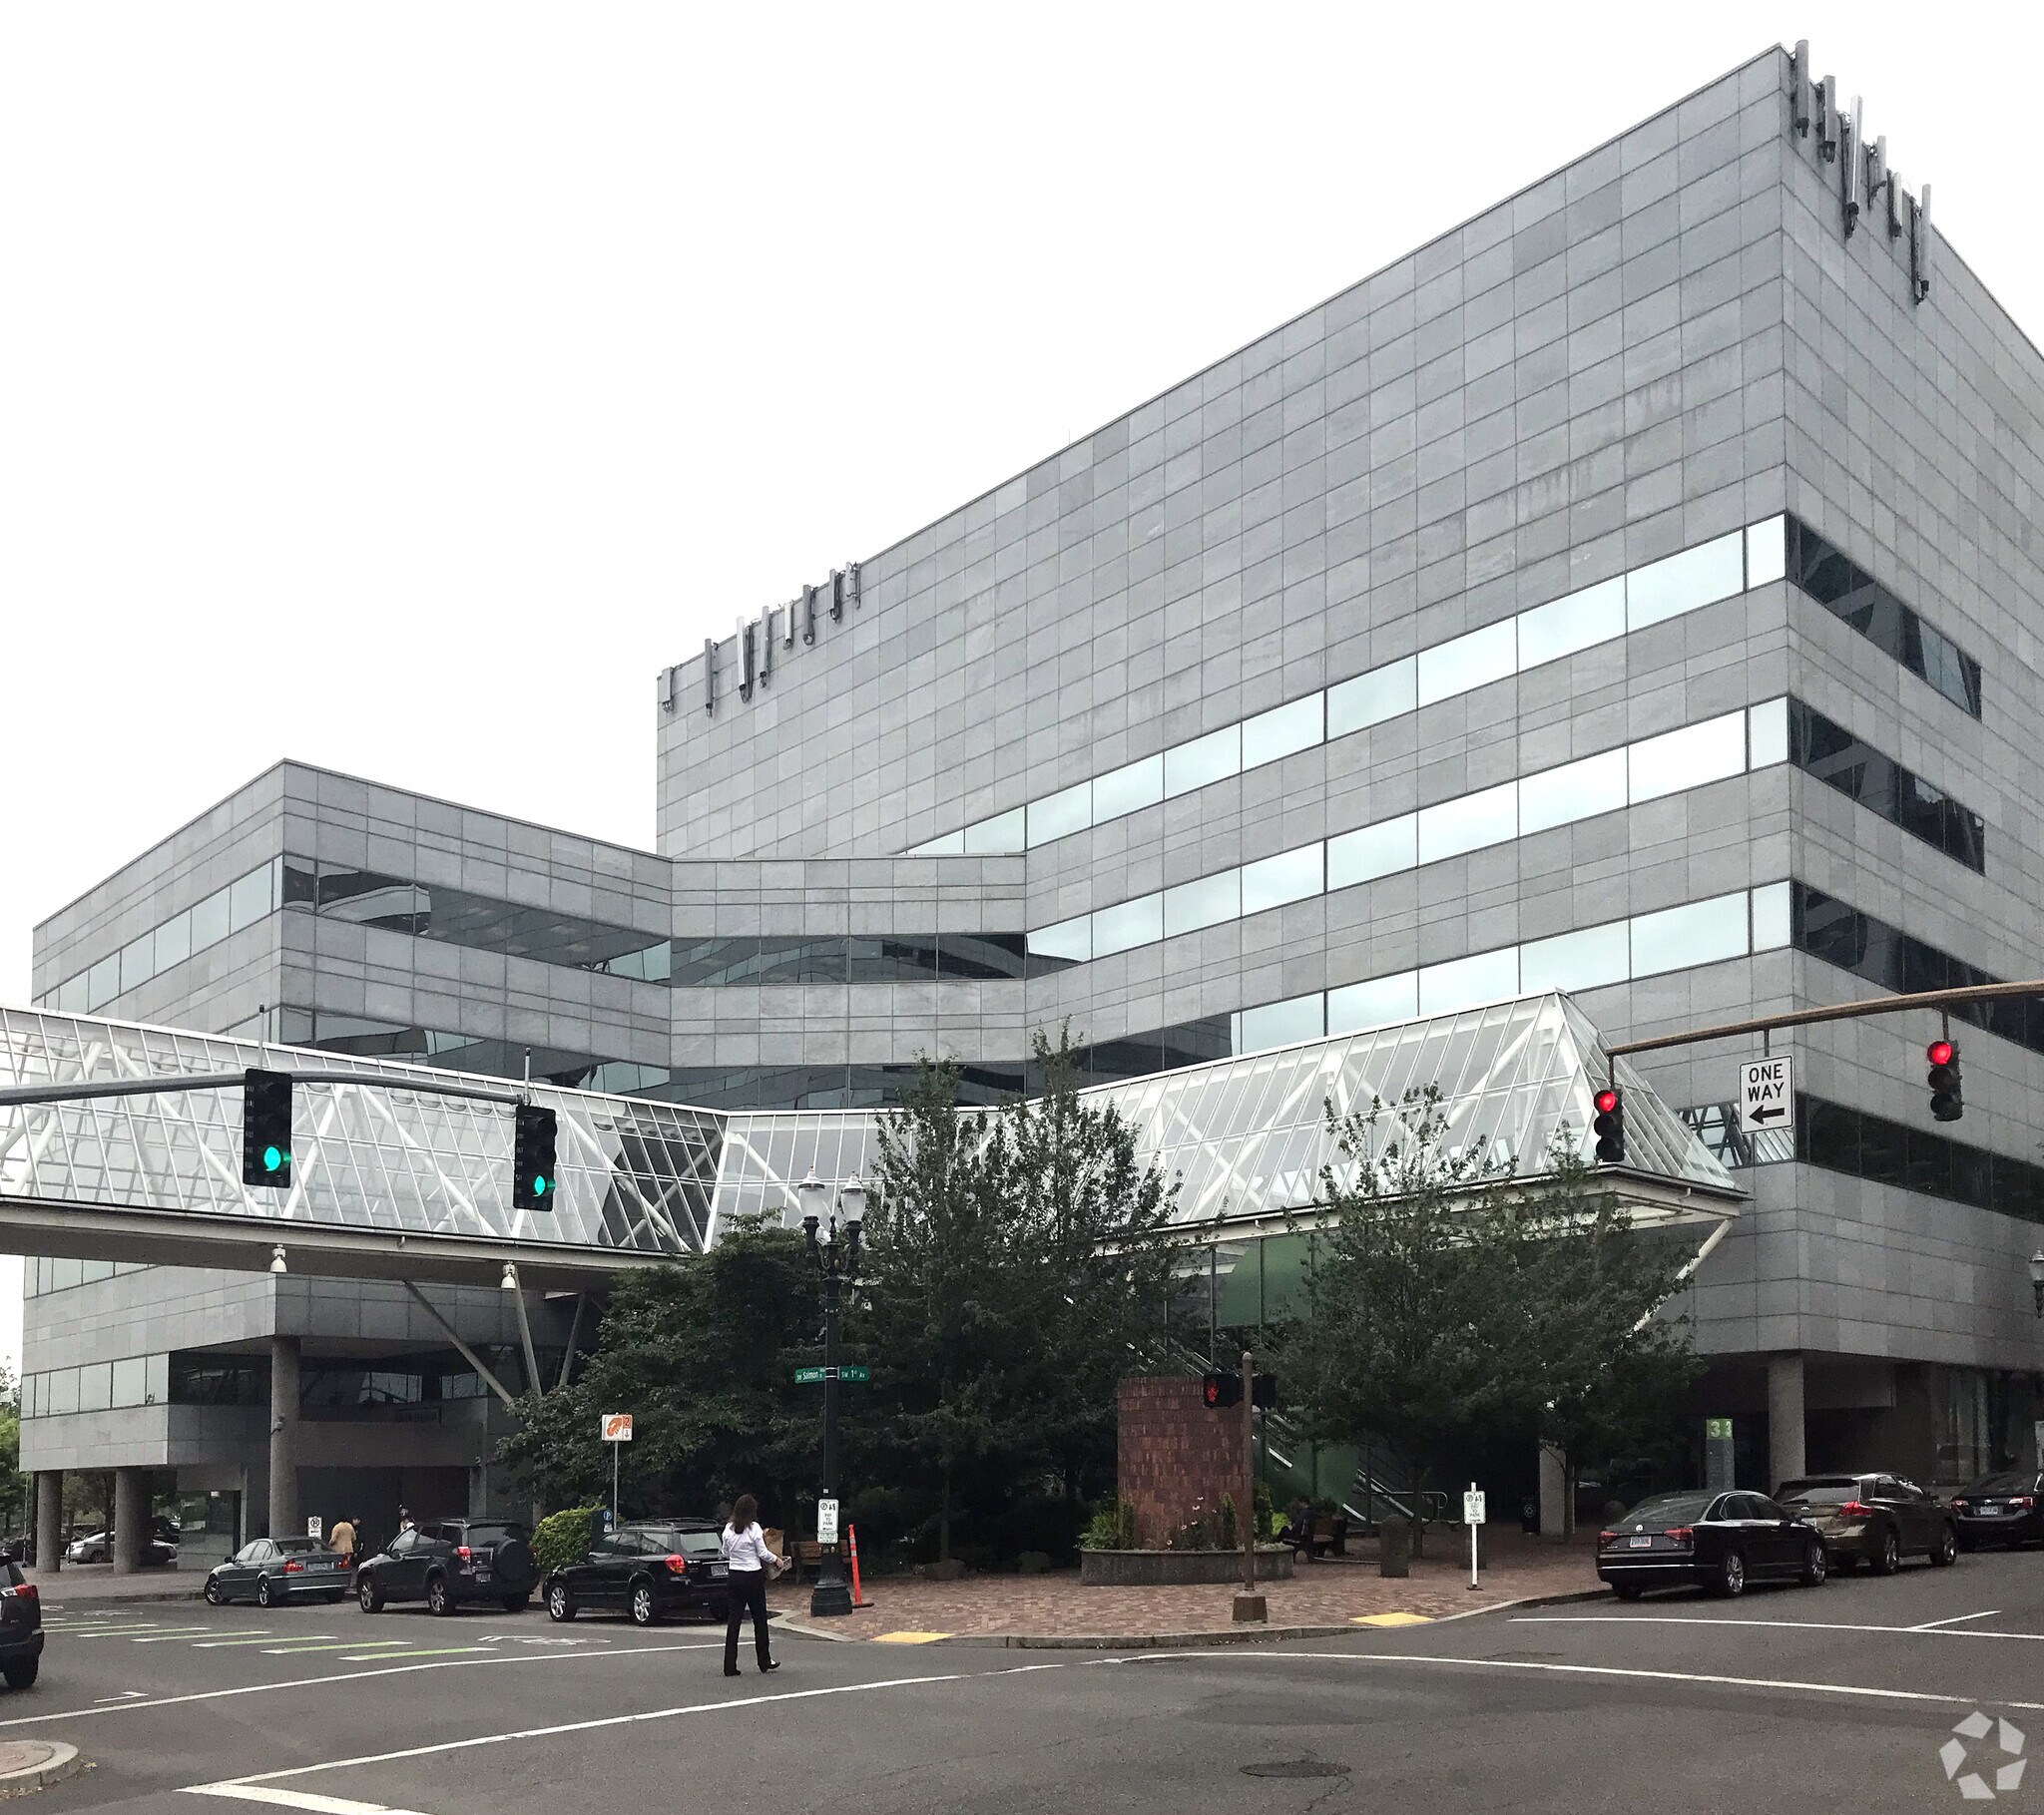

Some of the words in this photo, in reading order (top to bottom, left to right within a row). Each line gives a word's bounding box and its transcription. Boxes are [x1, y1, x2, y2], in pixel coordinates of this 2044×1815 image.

[1749, 1063, 1783, 1083] ONE
[1748, 1082, 1784, 1102] WAY
[803, 1371, 818, 1380] Salmon
[625, 1417, 629, 1426] 2
[1711, 1421, 1720, 1437] 3
[1726, 1421, 1731, 1437] 3
